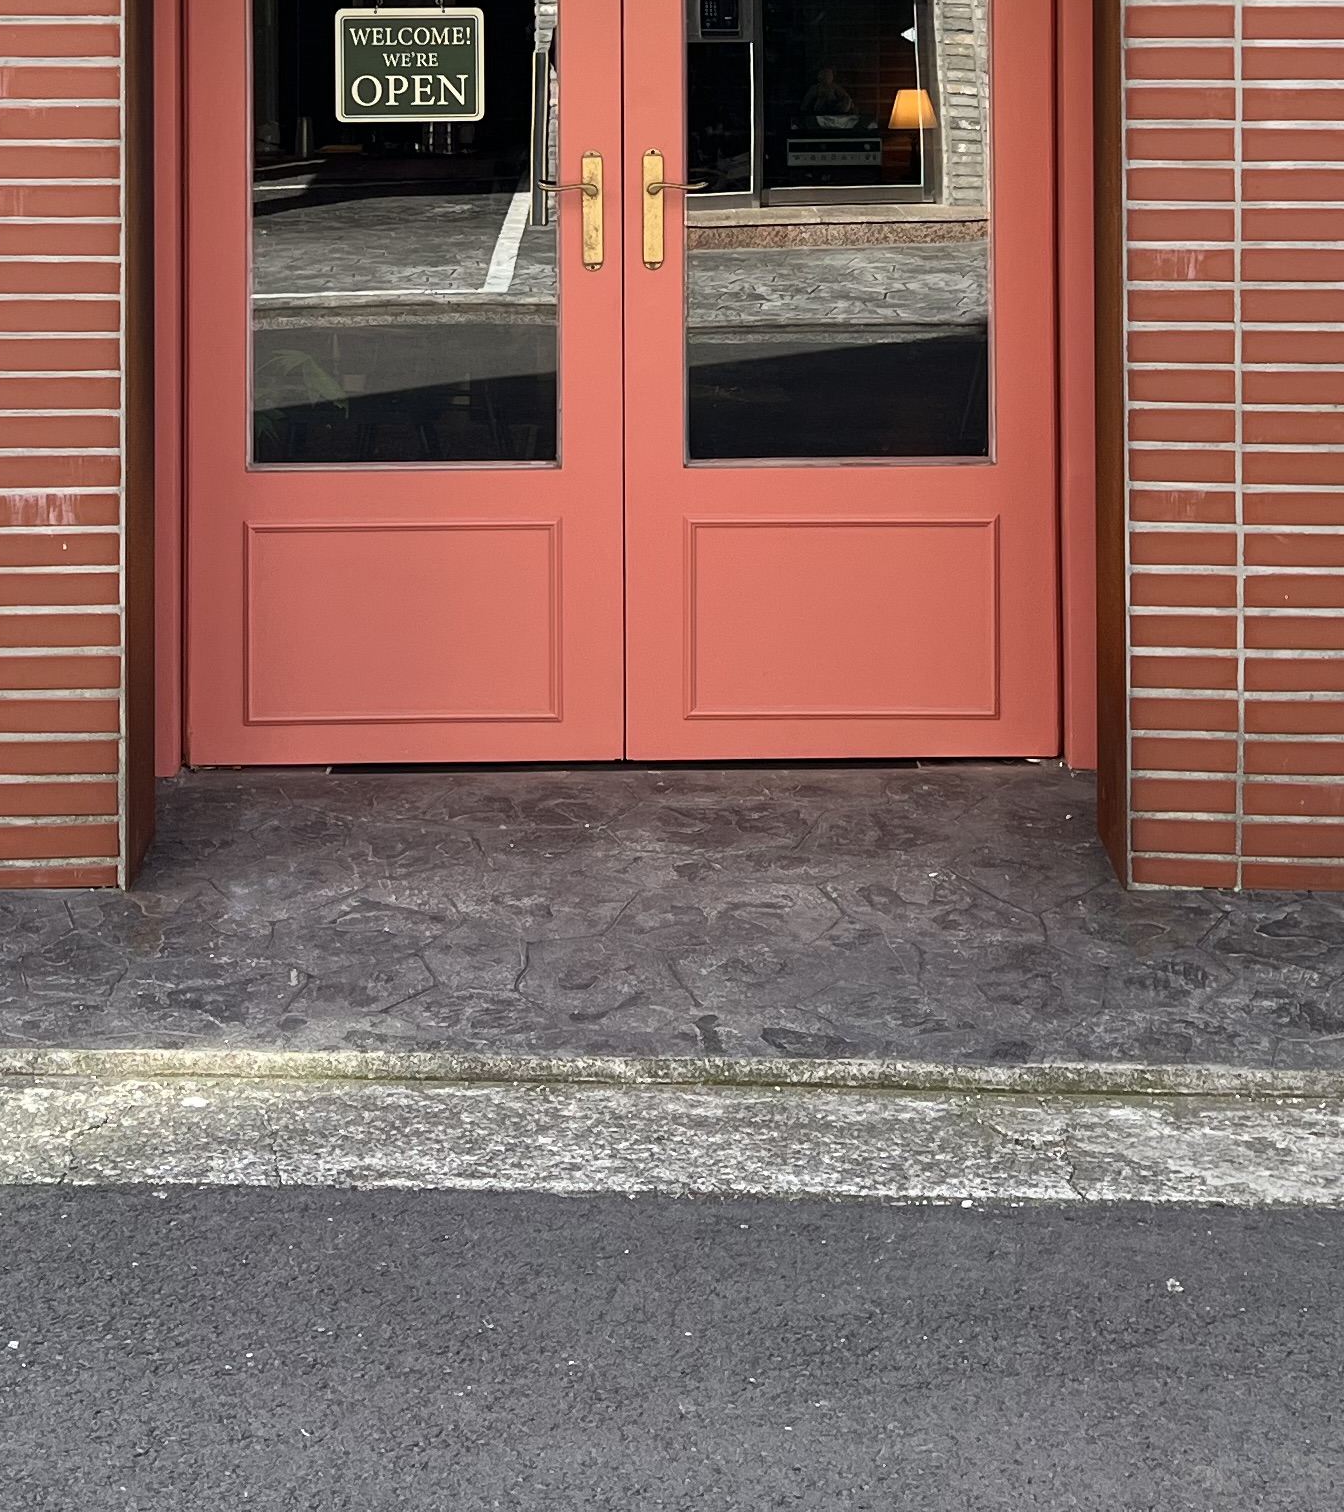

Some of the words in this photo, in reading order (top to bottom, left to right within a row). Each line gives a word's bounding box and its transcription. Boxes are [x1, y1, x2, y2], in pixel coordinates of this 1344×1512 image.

[349, 27, 471, 46] WELCOME!
[382, 52, 438, 67] WE'RE
[351, 74, 469, 107] OPEN
